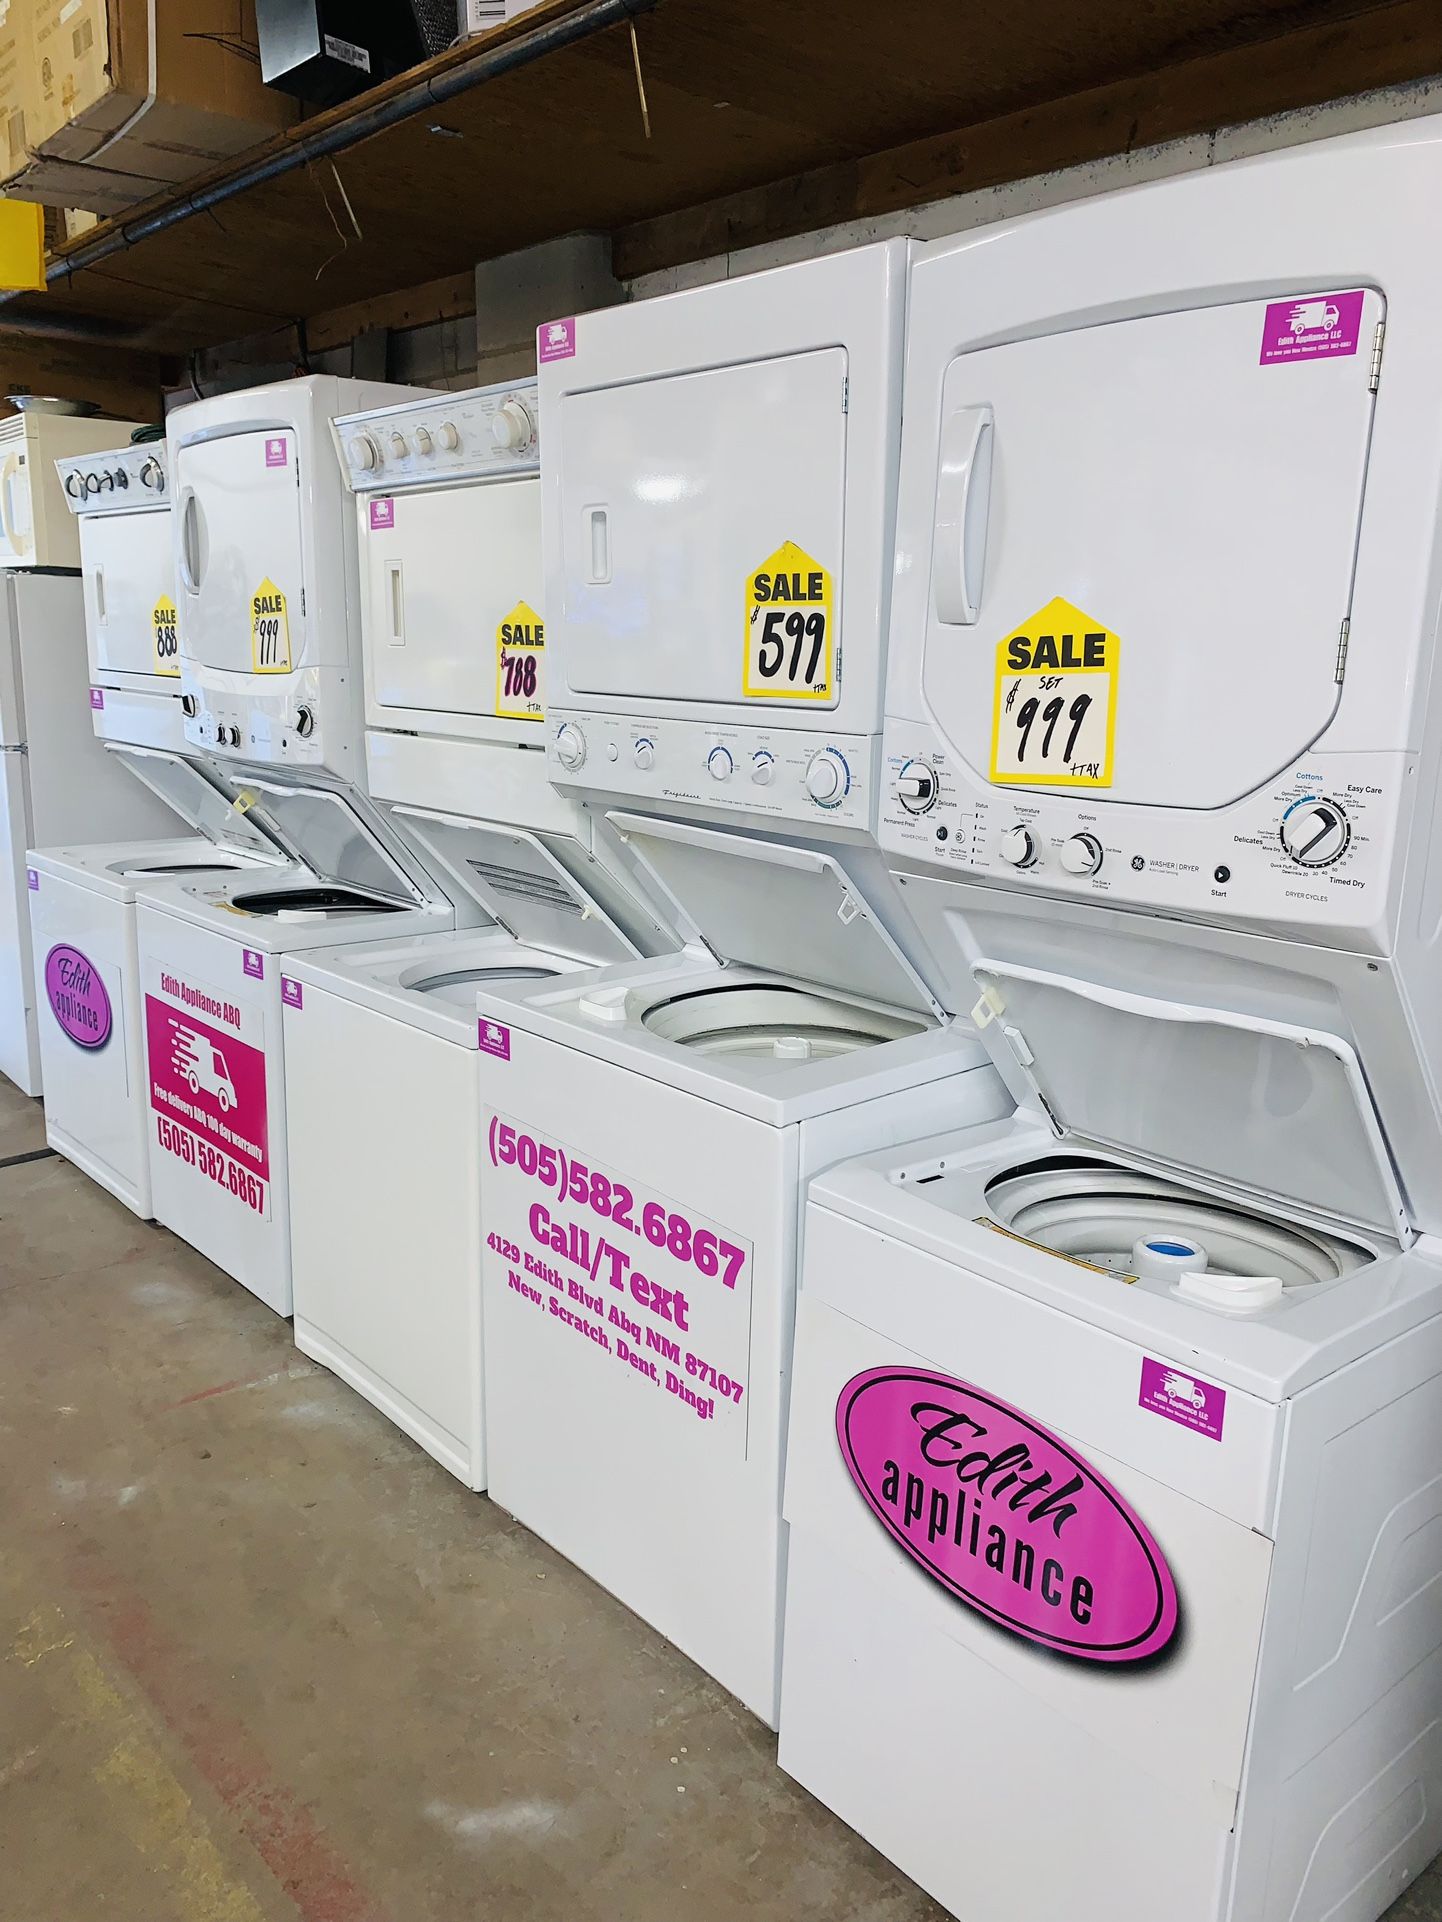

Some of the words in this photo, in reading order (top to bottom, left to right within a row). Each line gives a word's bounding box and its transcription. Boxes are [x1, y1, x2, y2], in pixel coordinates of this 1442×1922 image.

[1278, 337, 1294, 346] Edith
[1296, 333, 1329, 344] Appliance
[1330, 330, 1342, 340] LLC
[754, 572, 823, 602] SALE
[154, 610, 176, 625] SALE
[254, 595, 282, 615] SALE
[501, 624, 544, 646] SALE
[1007, 634, 1106, 670] SALE
[1038, 676, 1063, 690] SET
[1296, 772, 1323, 780] Cottons
[1348, 784, 1364, 794] Easy
[1366, 786, 1383, 794] Care
[884, 818, 904, 826] Permanent
[1014, 806, 1040, 814] Temperature
[1234, 836, 1263, 845] Delicates
[1211, 890, 1227, 898] Start
[1286, 890, 1305, 899] DRYER
[1306, 894, 1328, 902] CYCLES
[1330, 876, 1351, 886] Timed
[1352, 880, 1366, 889] Dry
[58, 958, 91, 997] Edith
[56, 990, 99, 1032] appliance
[161, 972, 180, 999] Edith
[181, 982, 221, 1019] Appliance
[223, 1002, 241, 1031] ABQ
[154, 1082, 168, 1102] Free
[168, 1091, 194, 1119] delivery
[194, 1106, 207, 1128] ABQ
[207, 1114, 219, 1134] 100
[219, 1122, 232, 1143] day
[232, 1132, 263, 1164] warranty
[158, 1116, 196, 1167] (505)
[198, 1140, 264, 1215] 582.6867
[489, 1115, 746, 1290] (505)582.6867
[529, 1203, 689, 1332] Call/Text
[486, 1232, 520, 1264] 4129
[524, 1252, 564, 1292] Edith
[568, 1278, 604, 1317] Blvd
[608, 1304, 642, 1345] Abq
[646, 1326, 681, 1366] NM
[685, 1352, 744, 1405] 87107
[508, 1270, 545, 1311] New,
[549, 1296, 612, 1355] Scratch,
[616, 1338, 661, 1387] Dent,
[666, 1370, 715, 1420] Ding!
[1154, 1391, 1168, 1403] Edith
[1168, 1398, 1198, 1416] Appliance
[1198, 1411, 1209, 1421] LLC
[910, 1402, 1084, 1540] Edith
[882, 1459, 1094, 1626] appliance
